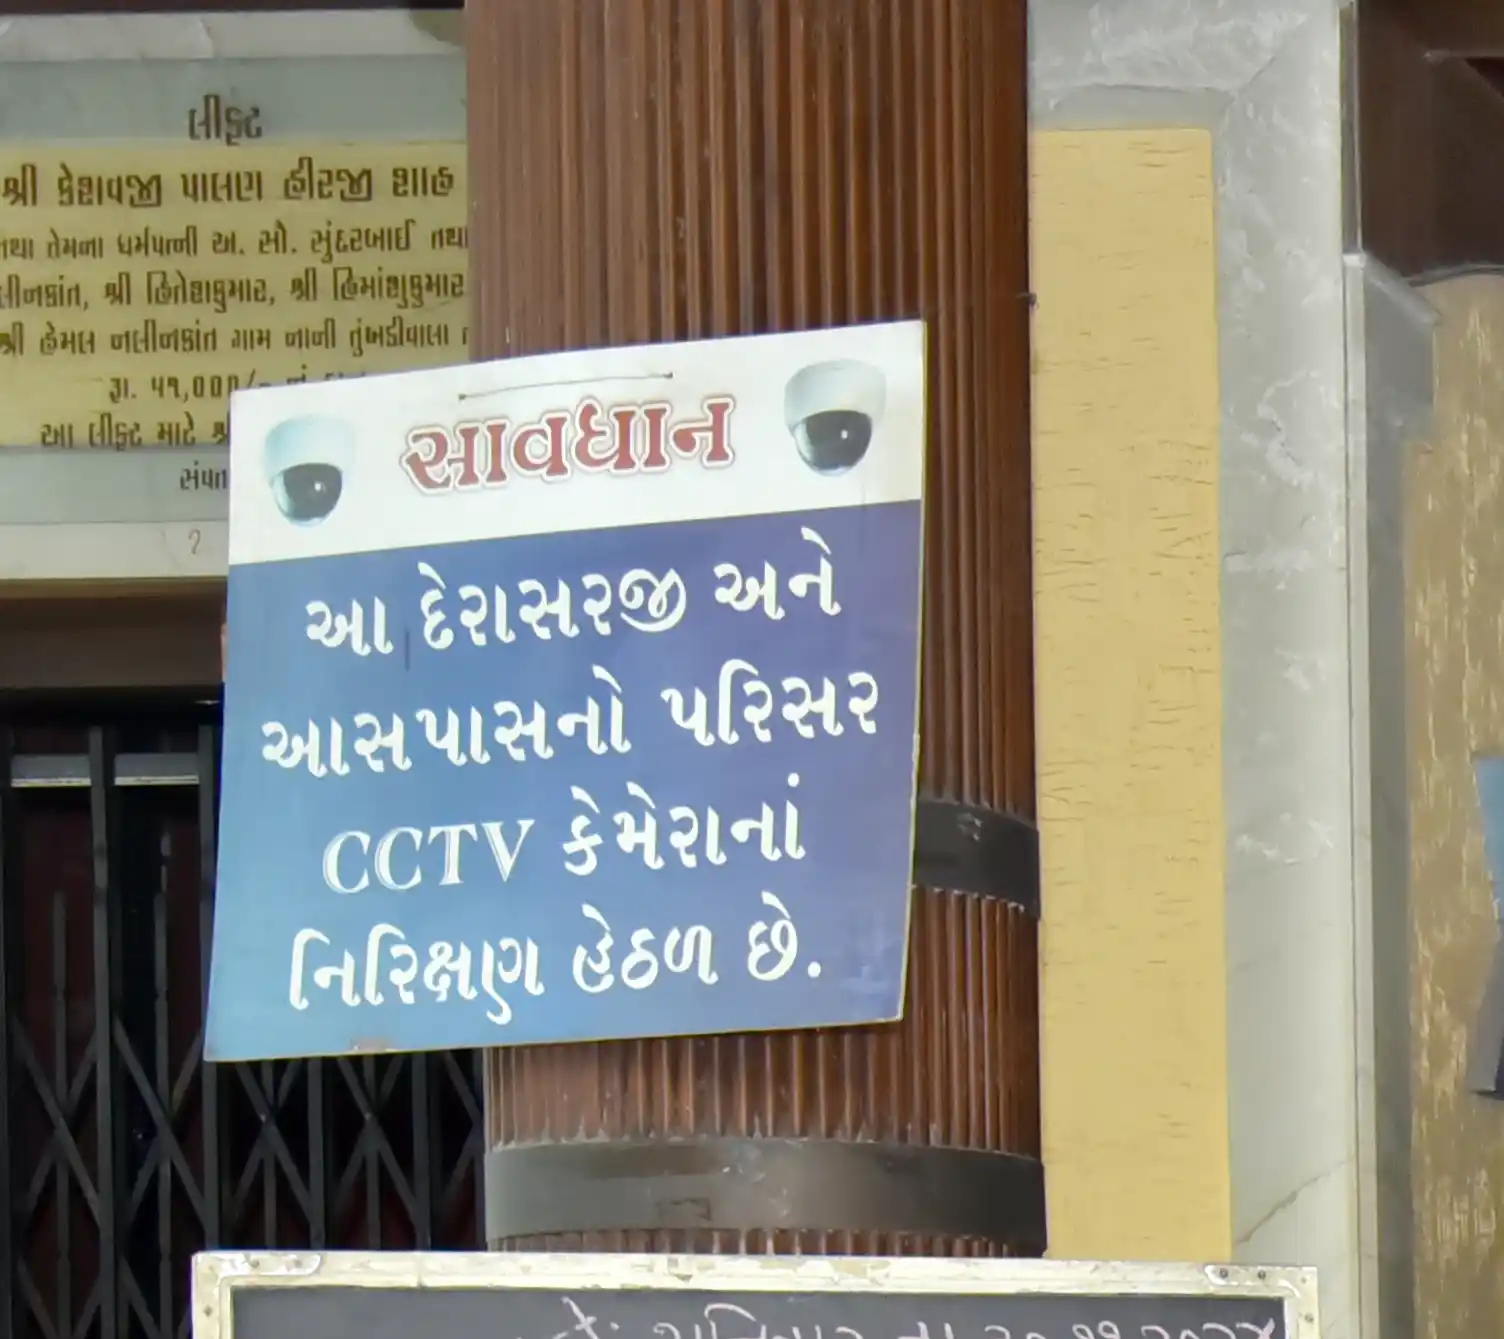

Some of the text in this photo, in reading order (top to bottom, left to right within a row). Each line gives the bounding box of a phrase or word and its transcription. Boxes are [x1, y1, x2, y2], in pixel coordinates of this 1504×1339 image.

[2, 157, 454, 207] શ્રી કેશવજી પાલણ હીરજી શાહ
[47, 227, 103, 259] તેમના
[310, 219, 416, 263] સુંદરબાઈ
[104, 271, 131, 305] શ્રી
[146, 269, 275, 313] હિતેશકુમાર,
[290, 267, 318, 301] શ્રી
[332, 265, 464, 309] હિમાંશુકુમાર
[40, 321, 95, 355] હેમલ
[111, 318, 217, 353] નલીનકાંત
[231, 327, 271, 351] ગામ
[285, 317, 336, 349] નાની
[41, 424, 73, 448] આ
[157, 411, 196, 446] માટે
[401, 396, 735, 494] સાવધાન
[306, 528, 841, 656] આ દેરાસરજી અને
[661, 659, 879, 746] પરિસર
[321, 773, 807, 895] CCTV કેમેરાનાં
[289, 891, 821, 1025] નિરિક્ષણ હેઠળ છે.
